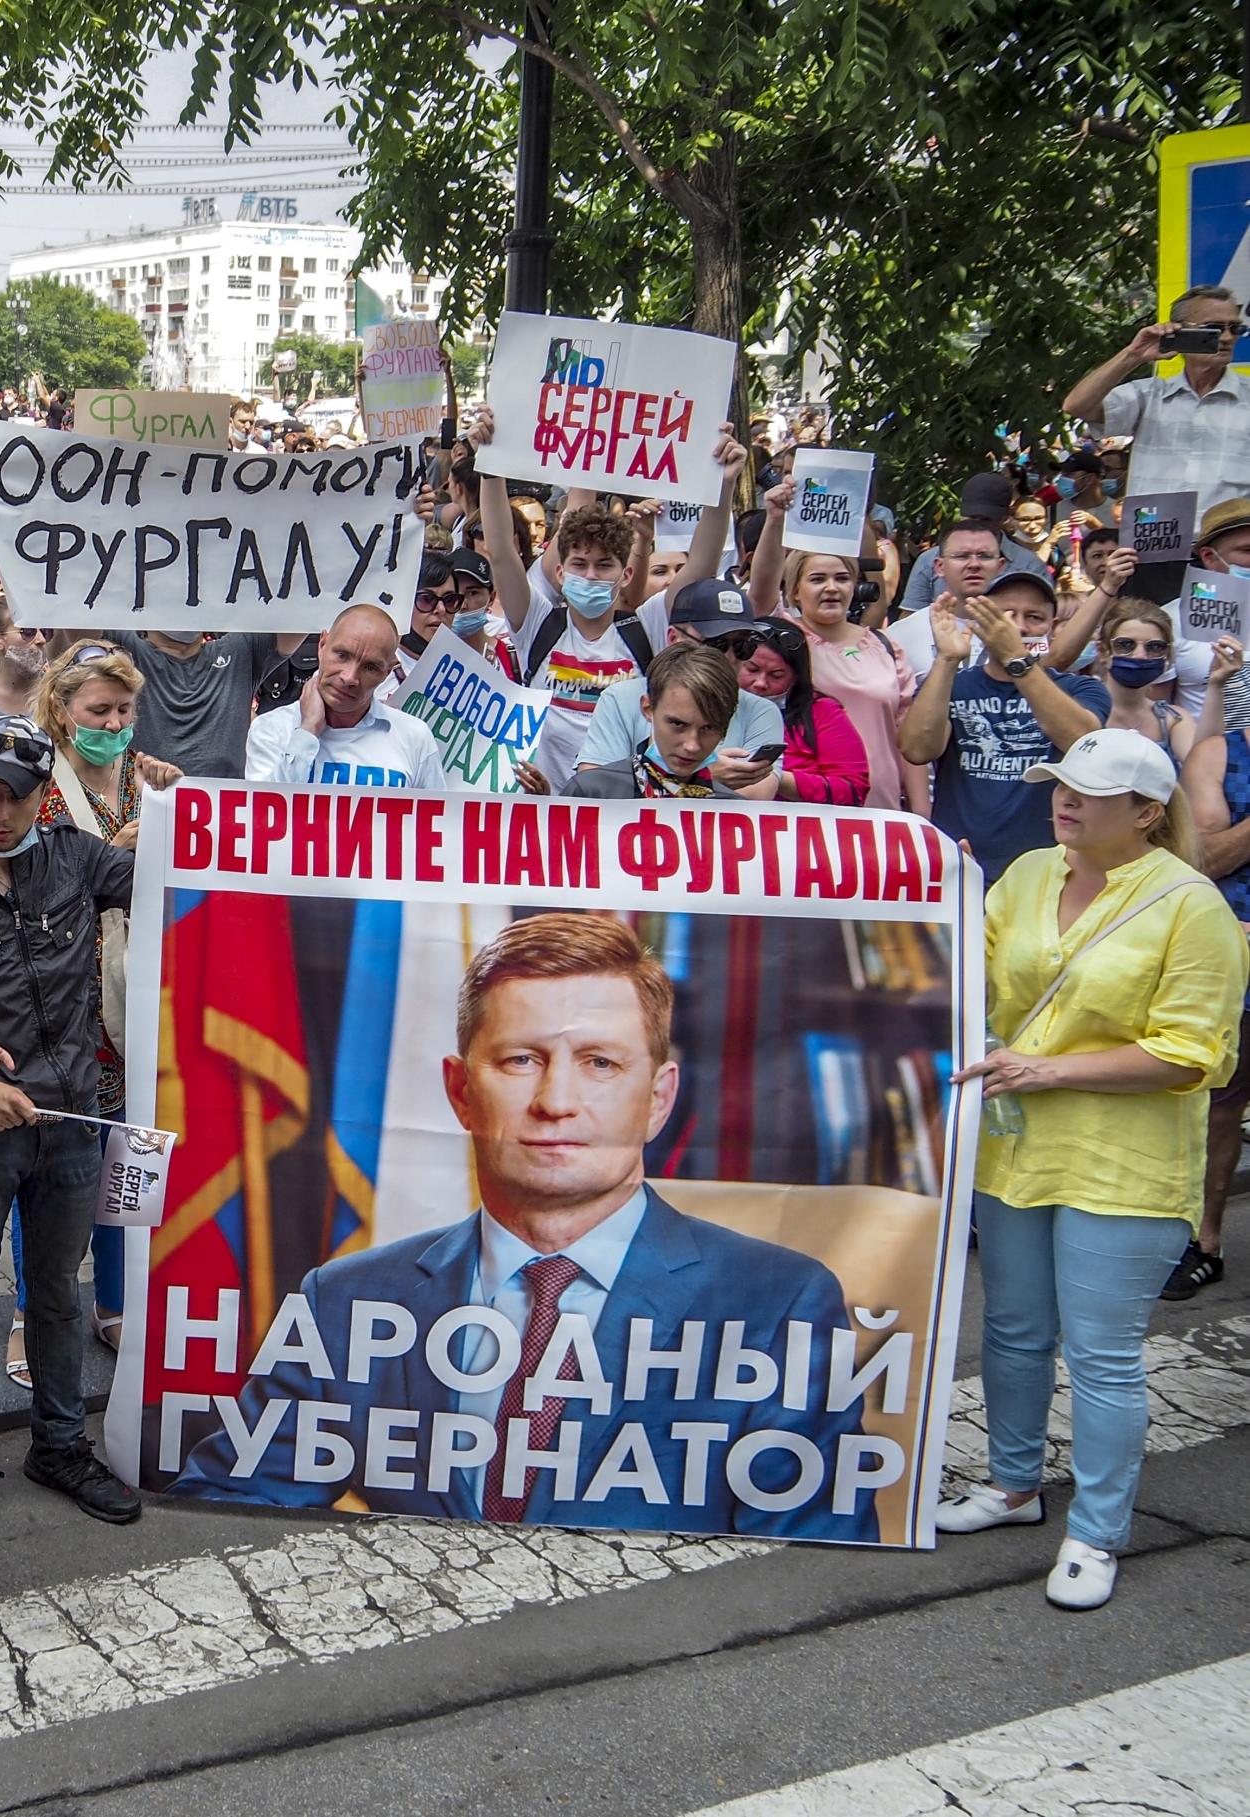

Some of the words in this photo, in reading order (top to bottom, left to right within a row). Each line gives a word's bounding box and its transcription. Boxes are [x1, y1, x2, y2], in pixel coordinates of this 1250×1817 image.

[193, 198, 215, 220] ВТБ
[260, 197, 297, 218] ВТБ
[537, 383, 694, 442] СЕРГЕЙ
[533, 424, 679, 484] ФУРГАЛ
[669, 507, 702, 522] ФУРГ
[800, 507, 850, 526] ФУРГАЛ
[802, 493, 848, 511] СЕРГЕЙ
[1134, 519, 1179, 538] СЕРГЕЙ
[1134, 535, 1181, 553] ФУРГАЛ
[15, 514, 403, 612] ФУРГАЛУ!
[1190, 597, 1238, 619] СЕРГЕЙ
[1190, 613, 1241, 635] ФУРГАЛ
[424, 653, 549, 750] СВОБОДУ
[401, 690, 539, 793] ФУРГАЛУ
[172, 787, 445, 883] ВЕРНИТЕ
[463, 801, 601, 890] НАМ
[618, 808, 945, 903] ФУРГАЛА!
[104, 1161, 124, 1214] ФУРГАЛ
[122, 1165, 142, 1212] СЕРГЕЙ
[163, 1286, 913, 1417] НАРОДНЫЙ
[159, 1392, 906, 1517] ГУБЕРНАТОР
